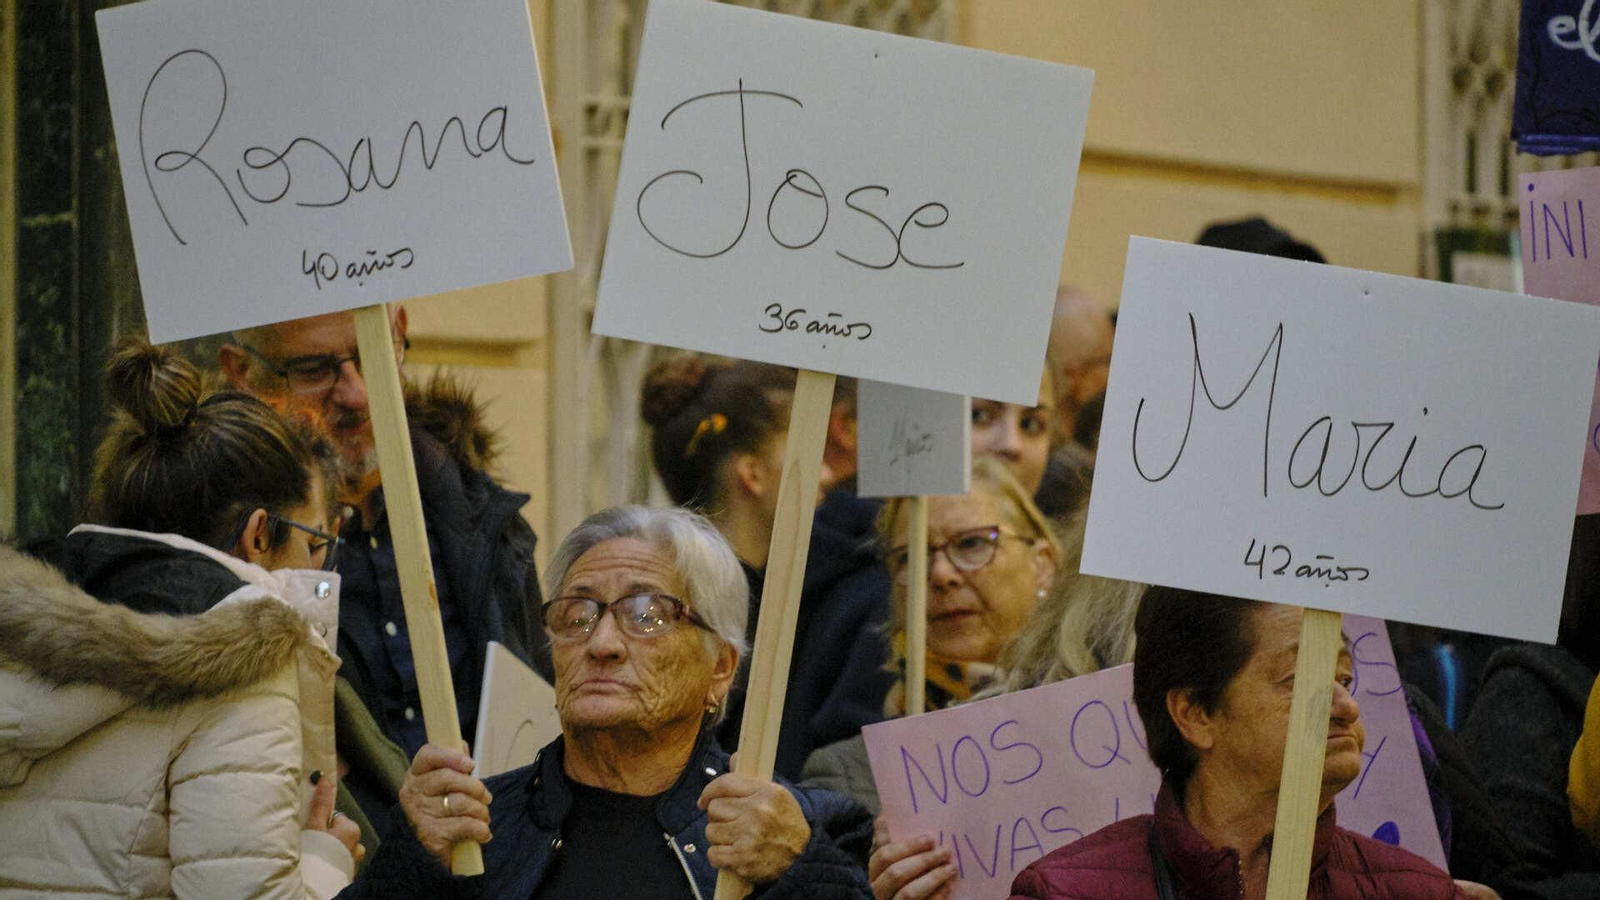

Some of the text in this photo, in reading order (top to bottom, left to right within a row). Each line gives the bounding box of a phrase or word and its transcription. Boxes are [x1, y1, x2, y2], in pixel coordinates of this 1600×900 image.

[139, 48, 535, 246] Rosana
[637, 77, 965, 270] Jose
[302, 246, 415, 291] 40 años
[758, 302, 873, 341] 36 años
[1243, 537, 1370, 582] 42 años
[900, 719, 1044, 813] NOS
[939, 805, 1085, 880] IVAS
